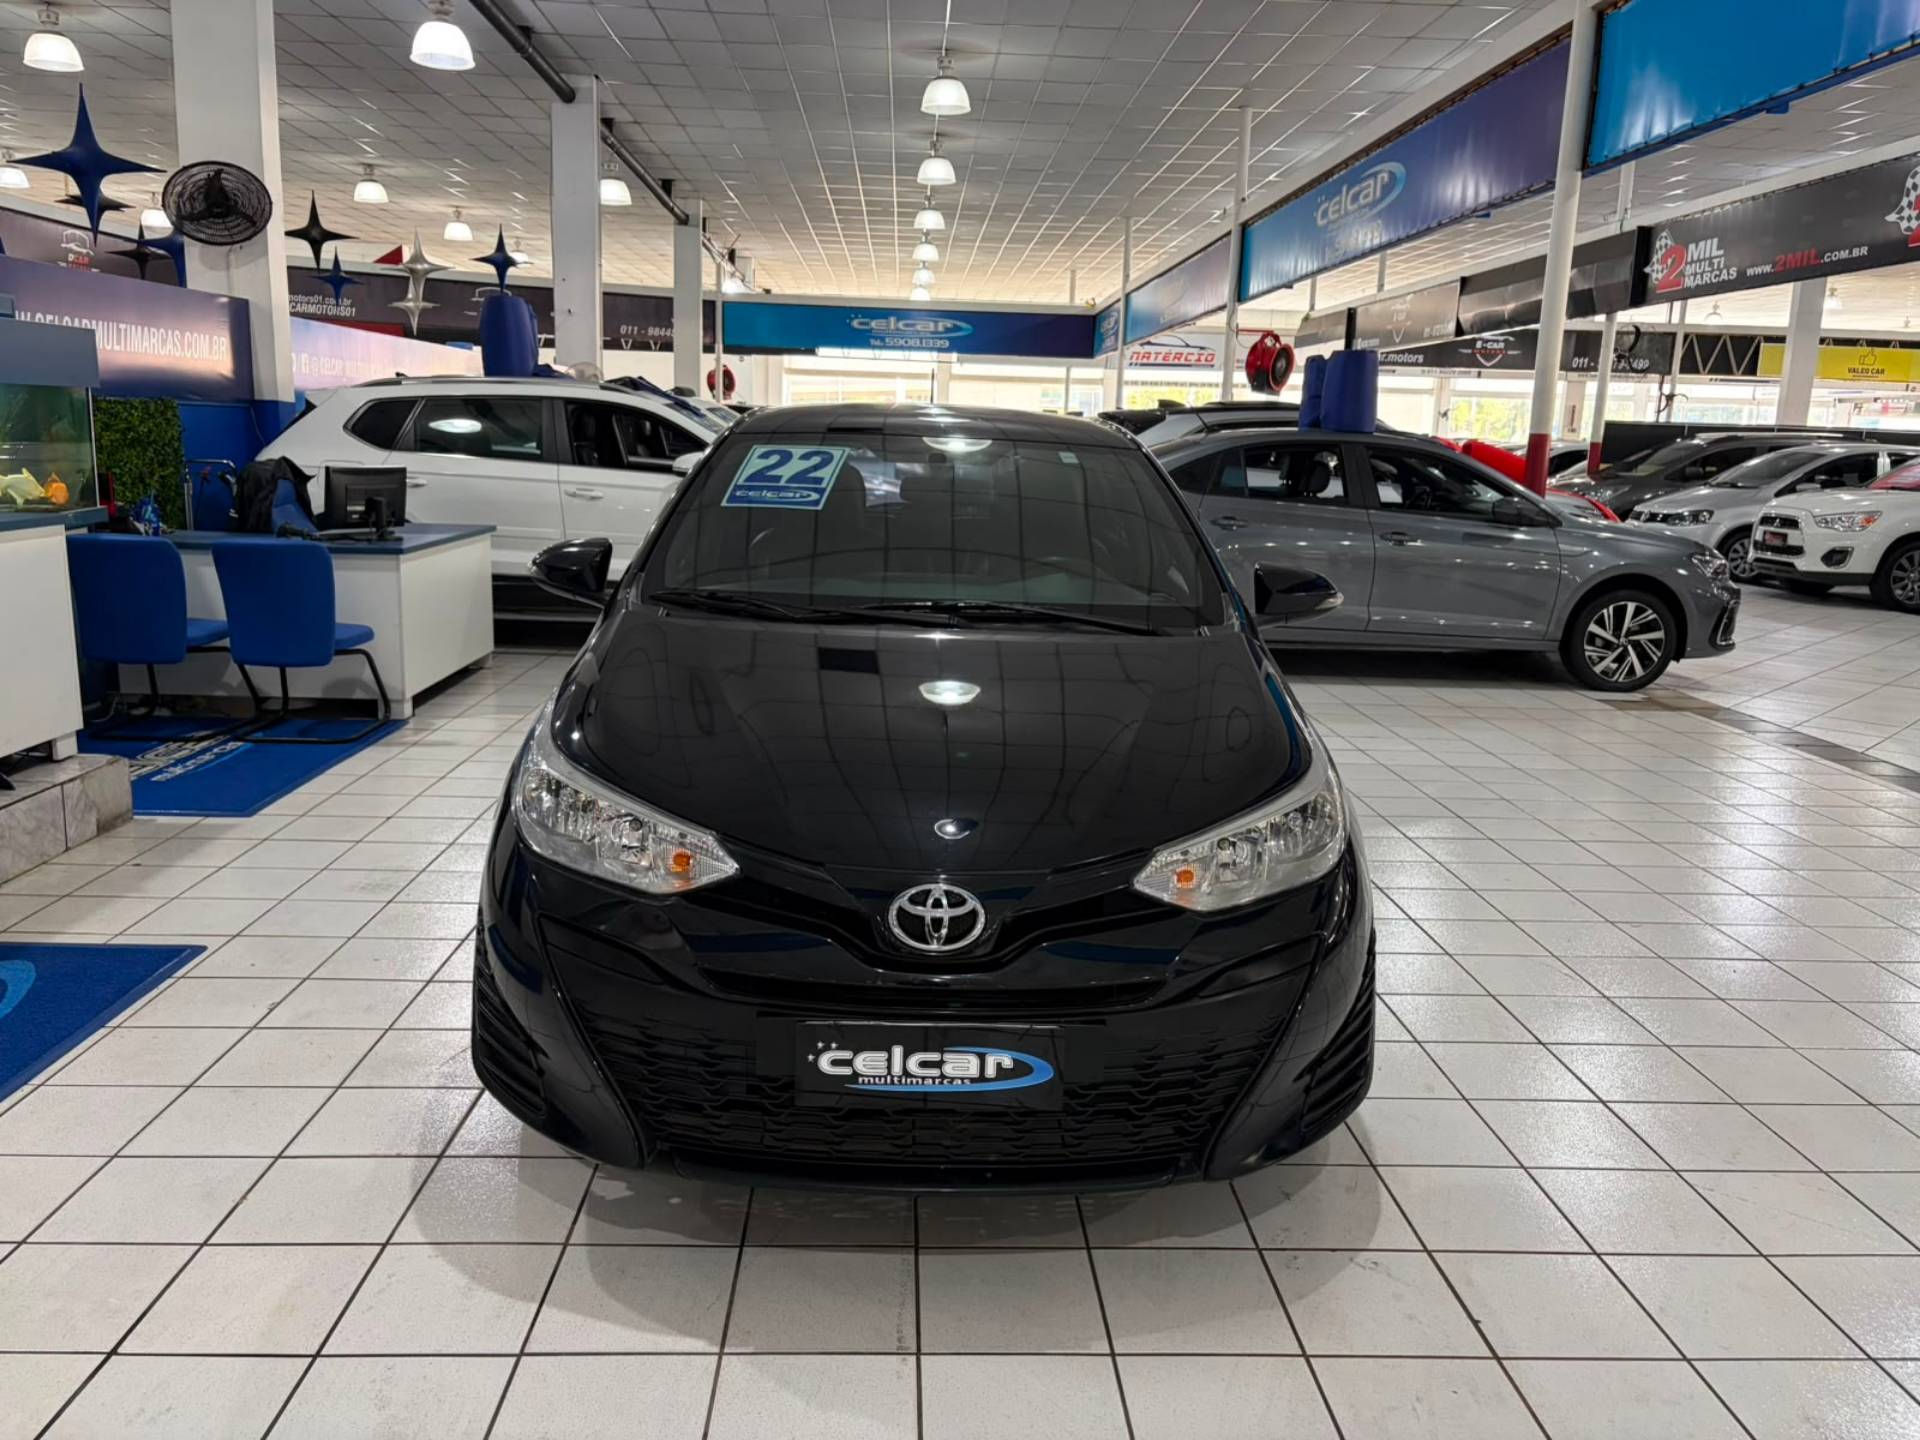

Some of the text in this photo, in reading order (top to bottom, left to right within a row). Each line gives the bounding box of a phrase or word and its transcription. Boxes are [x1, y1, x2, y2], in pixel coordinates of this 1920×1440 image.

[1316, 169, 1389, 226] celcar
[1656, 237, 1725, 293] 2 MIL
[1685, 256, 1725, 277] MULTI
[1684, 267, 1738, 289] MARCAS
[620, 324, 638, 335] 011
[851, 316, 954, 332] celcar
[1572, 356, 1589, 369] 011
[743, 449, 835, 486] 22
[816, 1045, 1014, 1078] celcar
[857, 1074, 972, 1086] multimarcas
